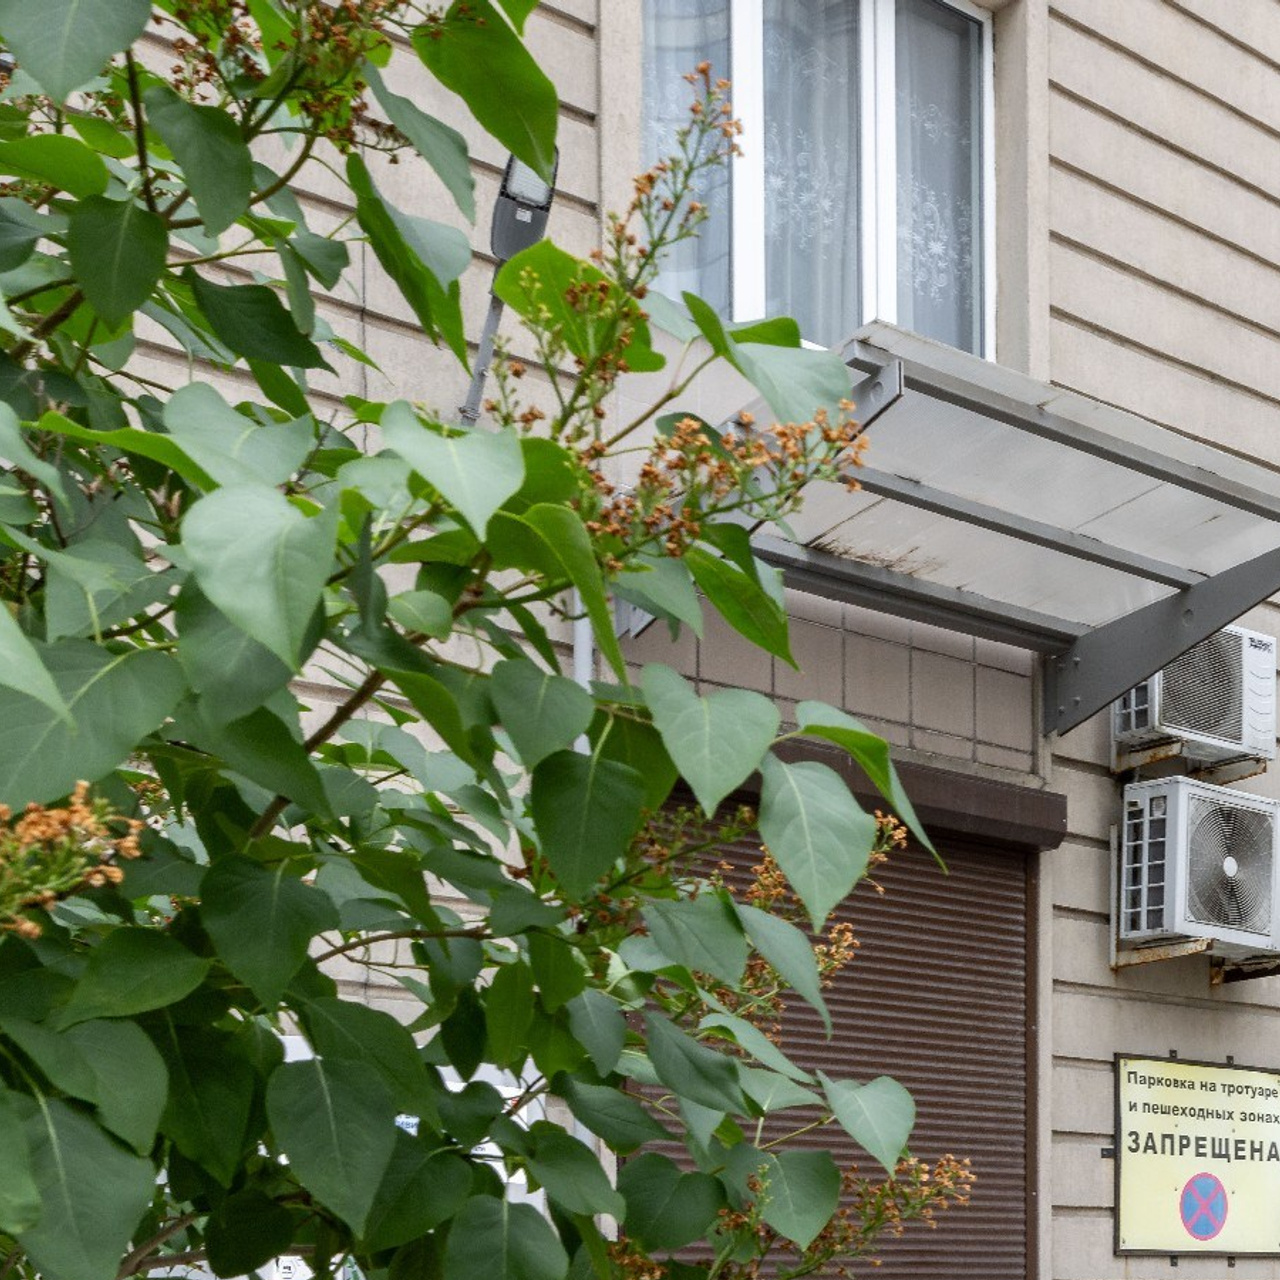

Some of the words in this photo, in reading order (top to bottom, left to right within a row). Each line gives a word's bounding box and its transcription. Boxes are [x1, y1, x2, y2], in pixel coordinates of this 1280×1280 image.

[1127, 1071, 1195, 1090] Парковка
[1200, 1080, 1217, 1092] на
[1221, 1083, 1279, 1100] тротуаре
[1129, 1101, 1138, 1112] и
[1142, 1102, 1234, 1121] пешеходных
[1239, 1111, 1280, 1124] зонах
[1127, 1131, 1280, 1163] ЗАПРЕЩЕНА
